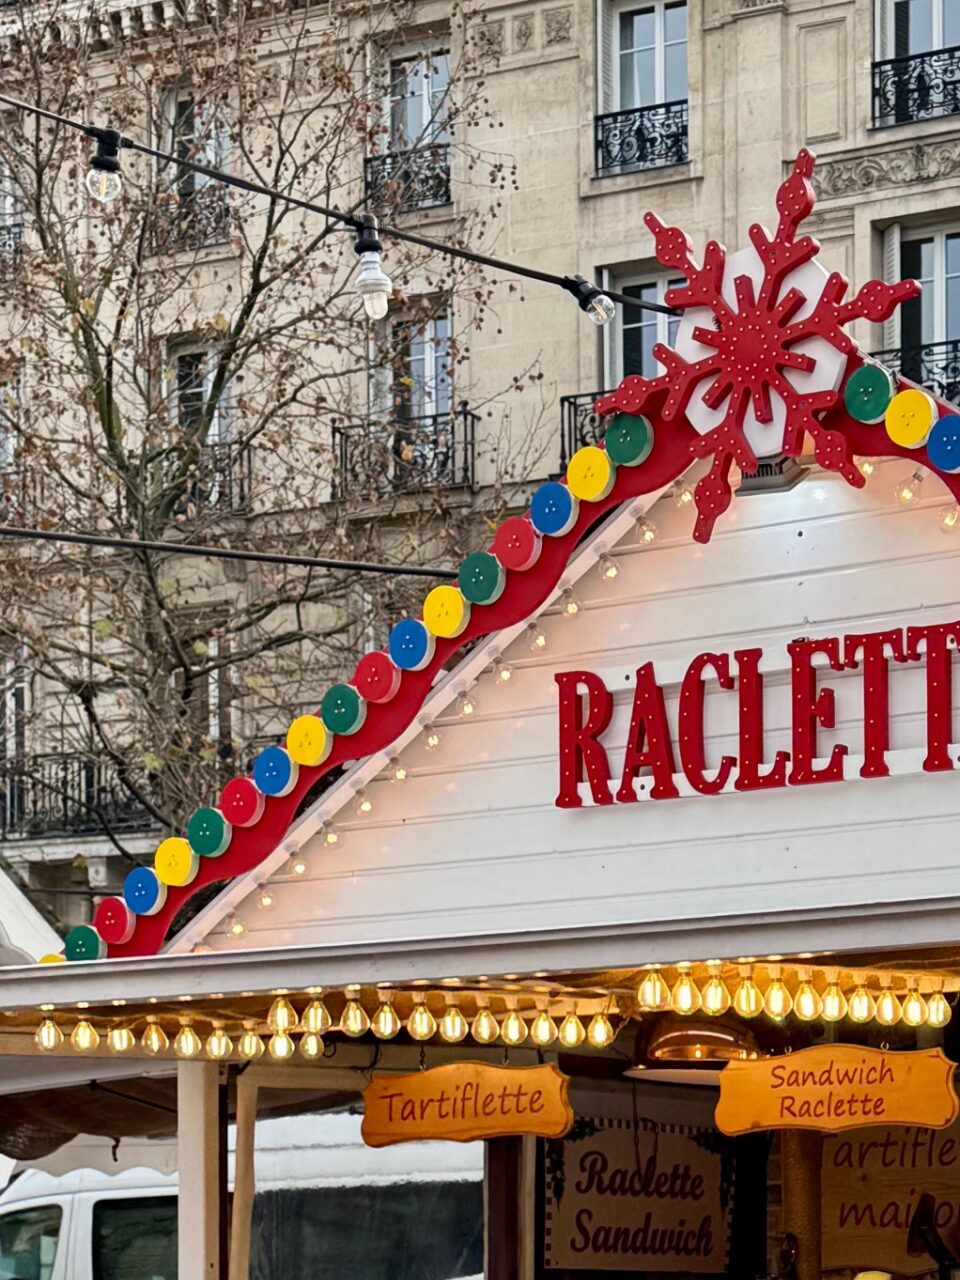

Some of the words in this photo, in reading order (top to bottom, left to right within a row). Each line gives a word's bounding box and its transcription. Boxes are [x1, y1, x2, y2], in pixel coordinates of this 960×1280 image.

[771, 1058, 895, 1089] Sandwich
[380, 1082, 546, 1123] Tartiflette
[780, 1091, 886, 1119] Raclette
[575, 1151, 705, 1201] Raclette
[570, 1208, 714, 1258] Sandwich
